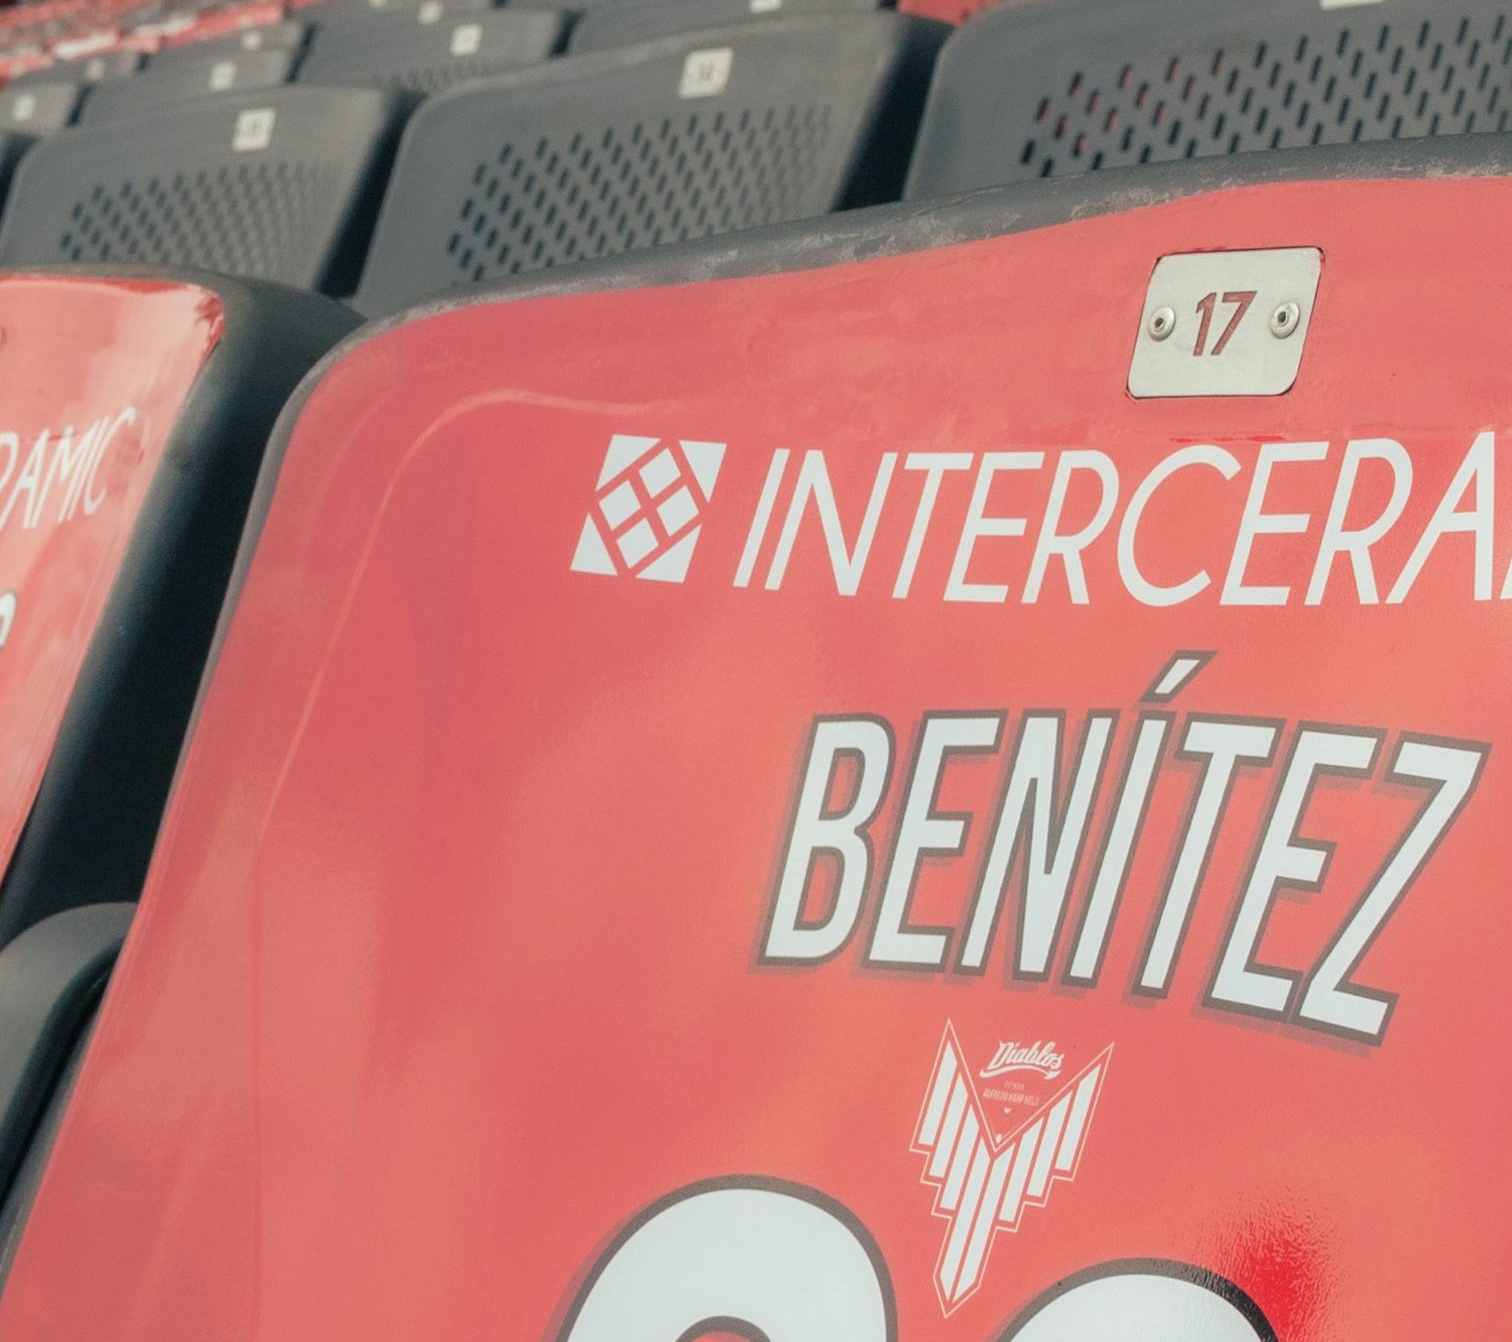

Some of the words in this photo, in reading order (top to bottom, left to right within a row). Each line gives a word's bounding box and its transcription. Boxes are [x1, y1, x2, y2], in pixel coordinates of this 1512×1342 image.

[1192, 290, 1259, 357] 17
[755, 650, 1492, 1046] BENÍTEZ
[984, 1040, 1065, 1073] Diablos
